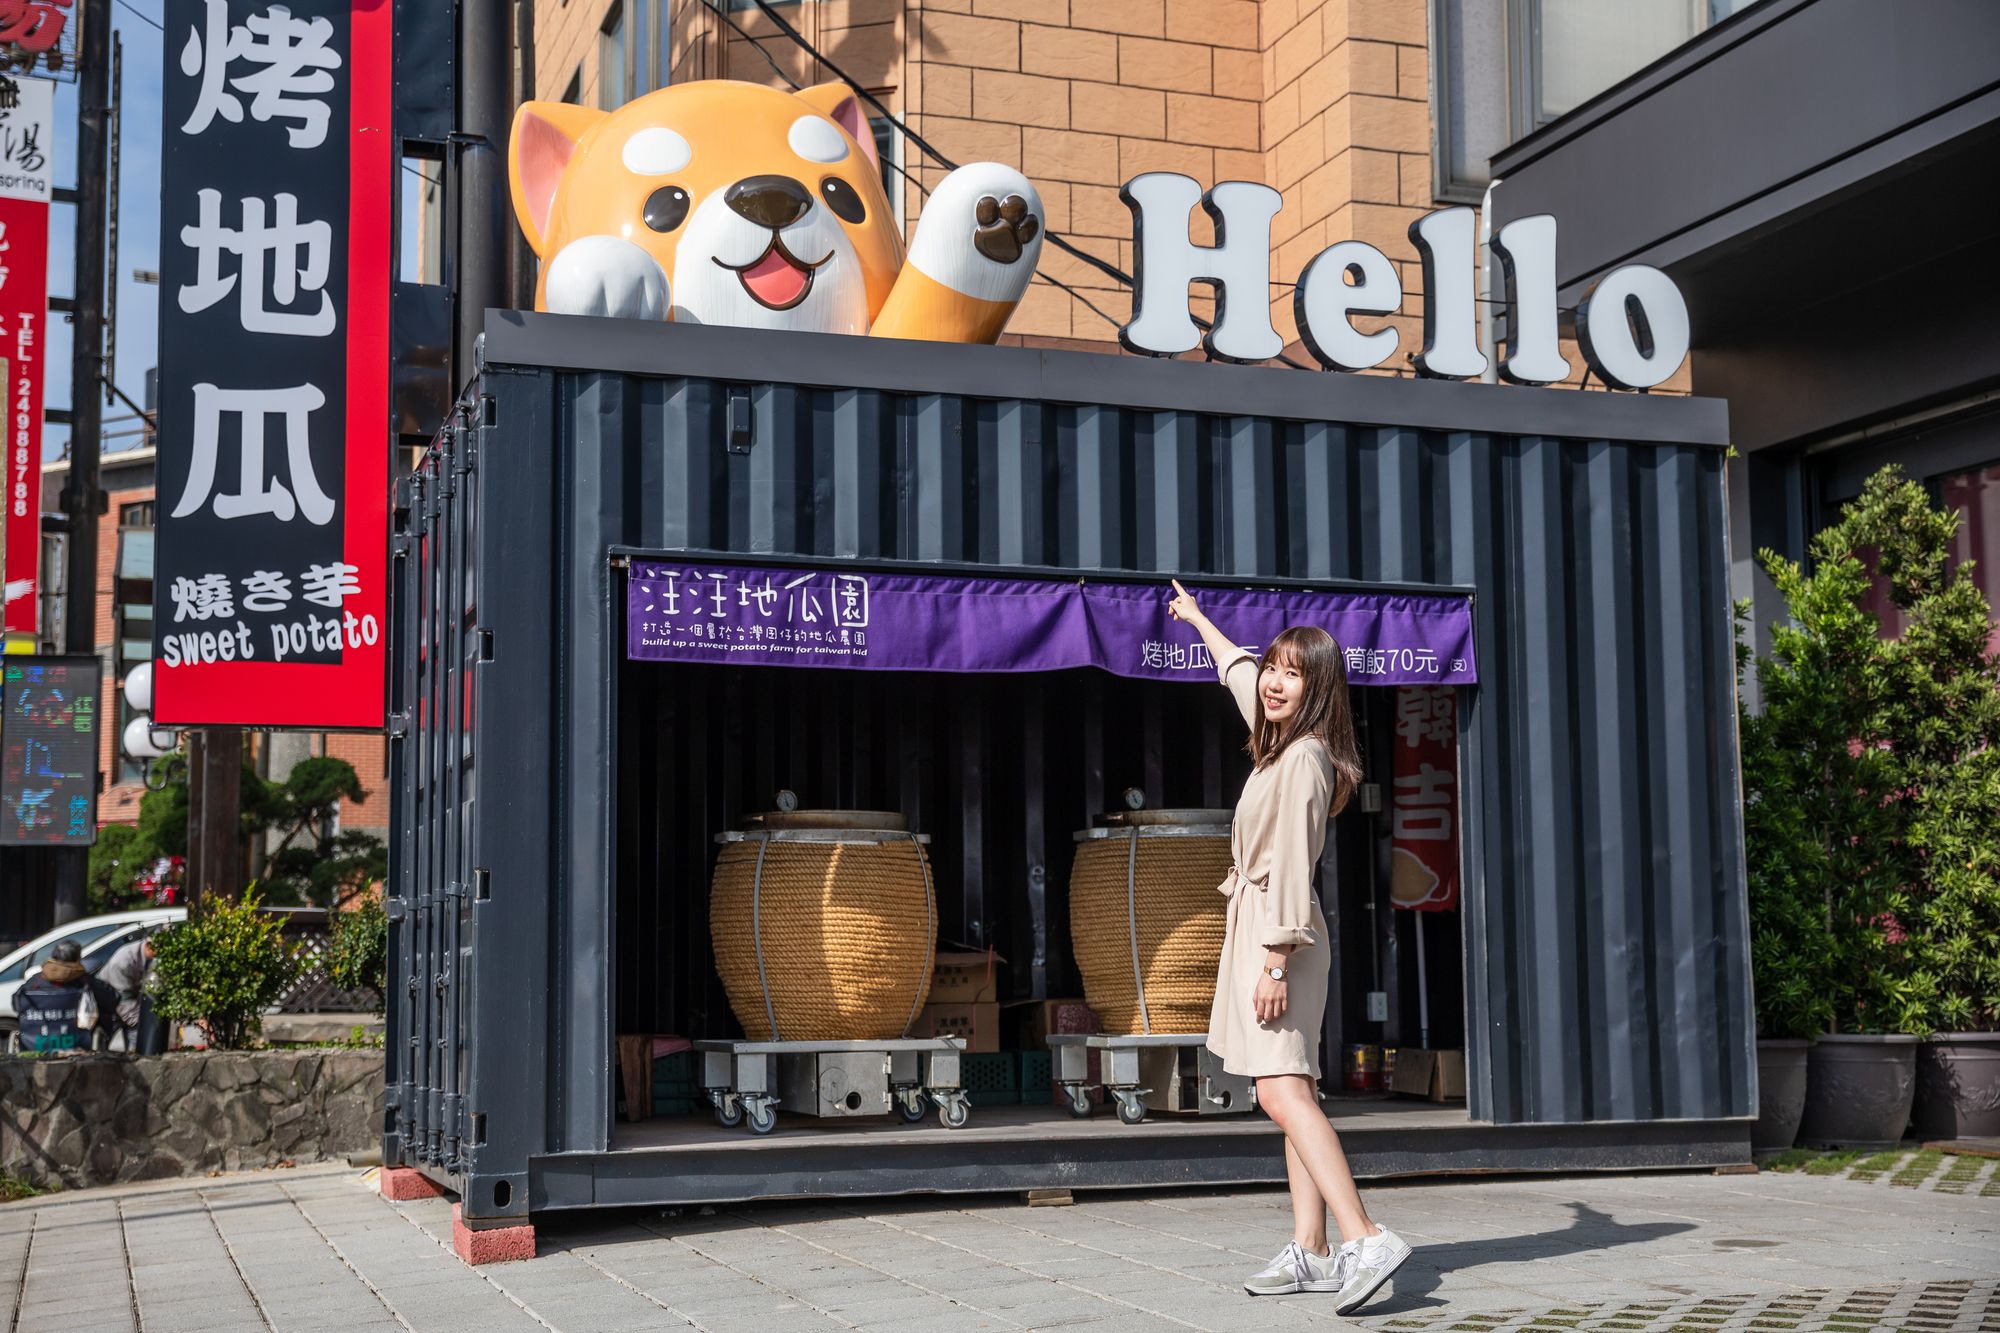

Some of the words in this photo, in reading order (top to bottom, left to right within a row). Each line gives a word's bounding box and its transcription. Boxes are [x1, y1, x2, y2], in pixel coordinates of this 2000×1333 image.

[171, 0, 343, 526] 烤地瓜
[1118, 171, 1691, 391] Hello
[641, 568, 869, 628] 汪汪地瓜園
[163, 620, 255, 669] sweet
[270, 610, 379, 662] potato
[642, 638, 670, 646] build
[672, 640, 687, 649] up
[697, 641, 729, 650] sweet
[730, 643, 768, 652] potato
[769, 644, 794, 653] farm
[795, 645, 813, 654] for
[814, 646, 851, 655] taiwan
[852, 648, 868, 656] kid
[1341, 646, 1439, 675] 筒飯70元
